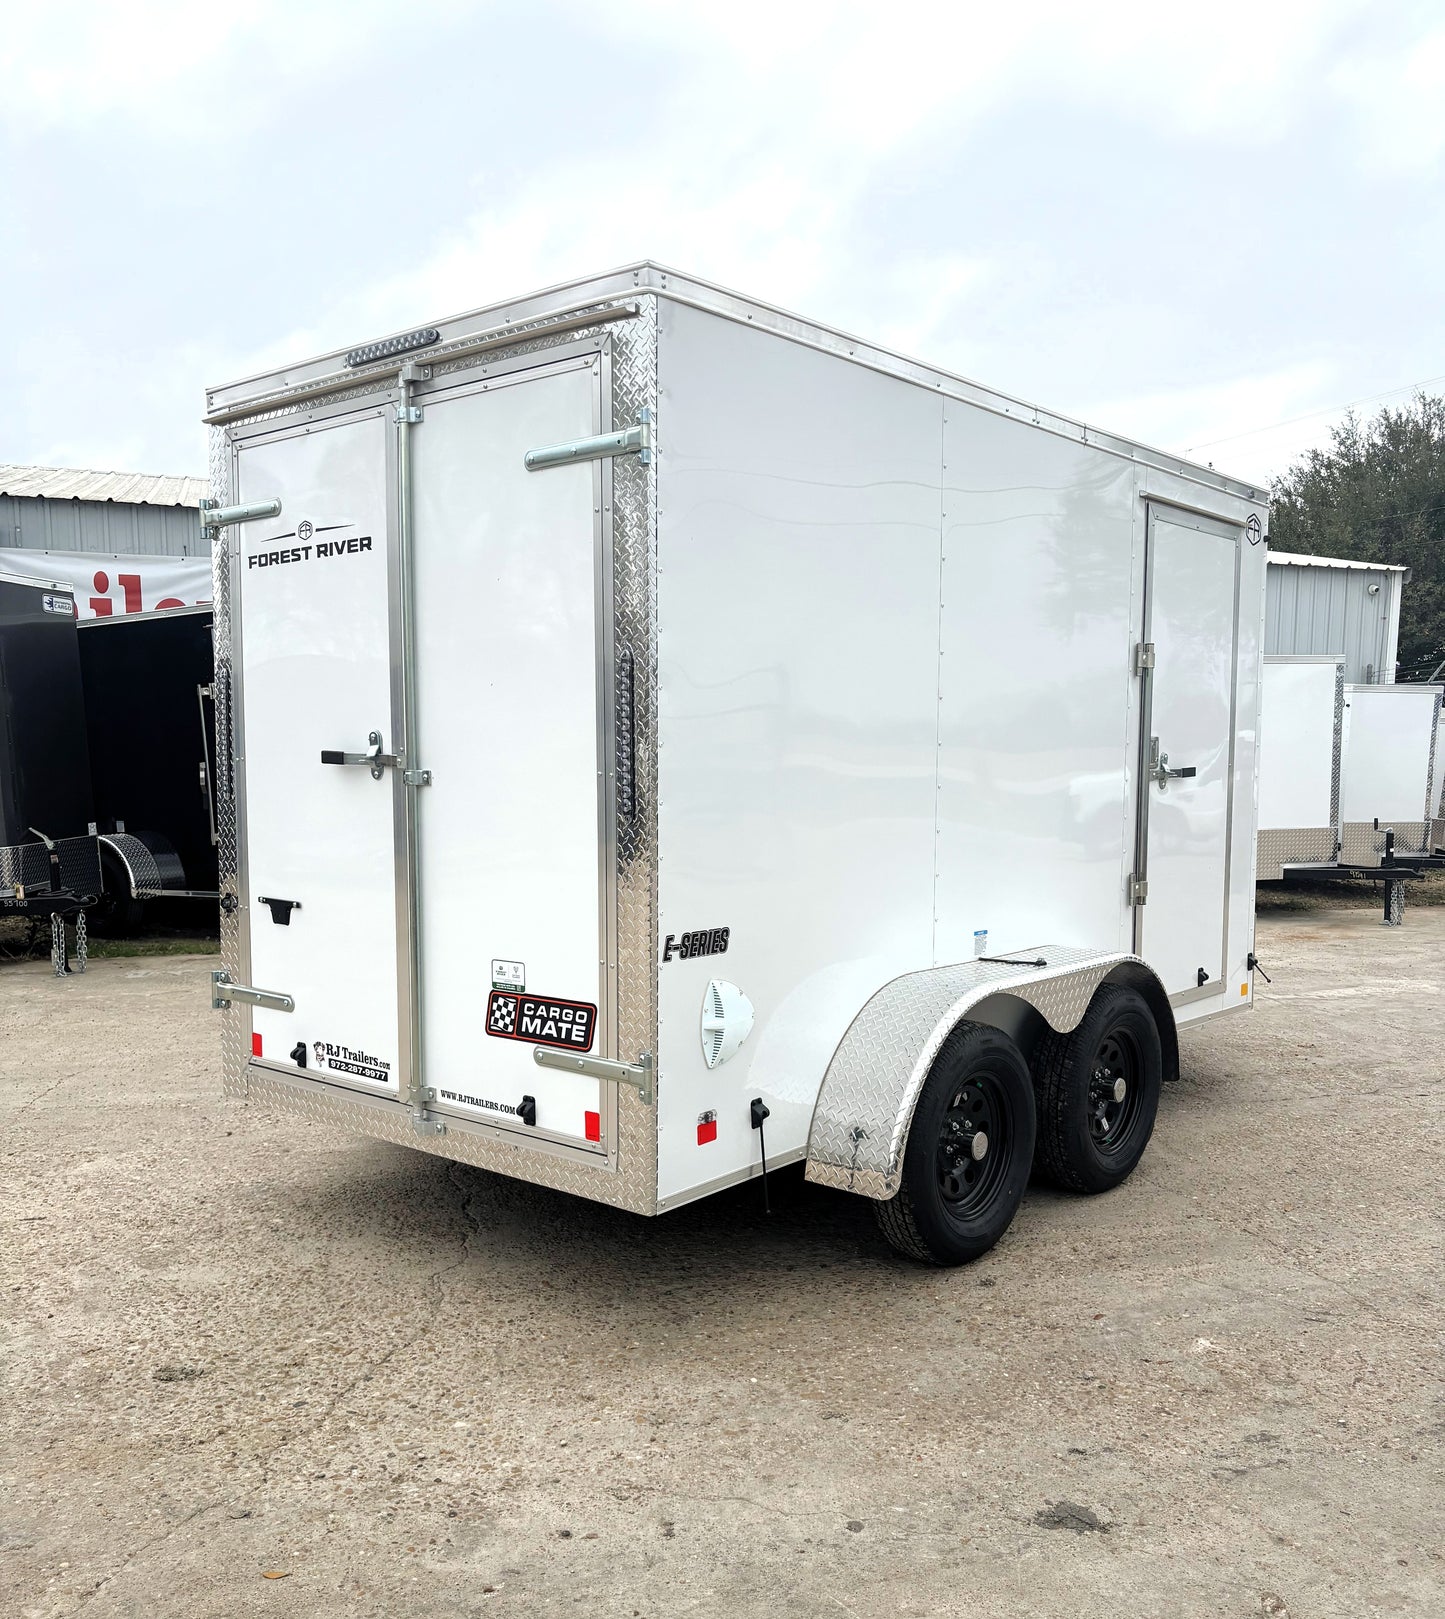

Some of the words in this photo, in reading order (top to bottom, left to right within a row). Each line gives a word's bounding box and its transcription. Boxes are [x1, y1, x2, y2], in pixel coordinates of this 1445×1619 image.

[248, 546, 312, 569] FOREST
[316, 536, 372, 558] RIVER
[662, 927, 730, 963] E-SERIES
[523, 1003, 588, 1024] CARGO
[521, 1016, 586, 1042] MATE
[325, 1043, 340, 1057] RJ
[440, 1089, 516, 1115] WWW.RJTRAILERS.COM
